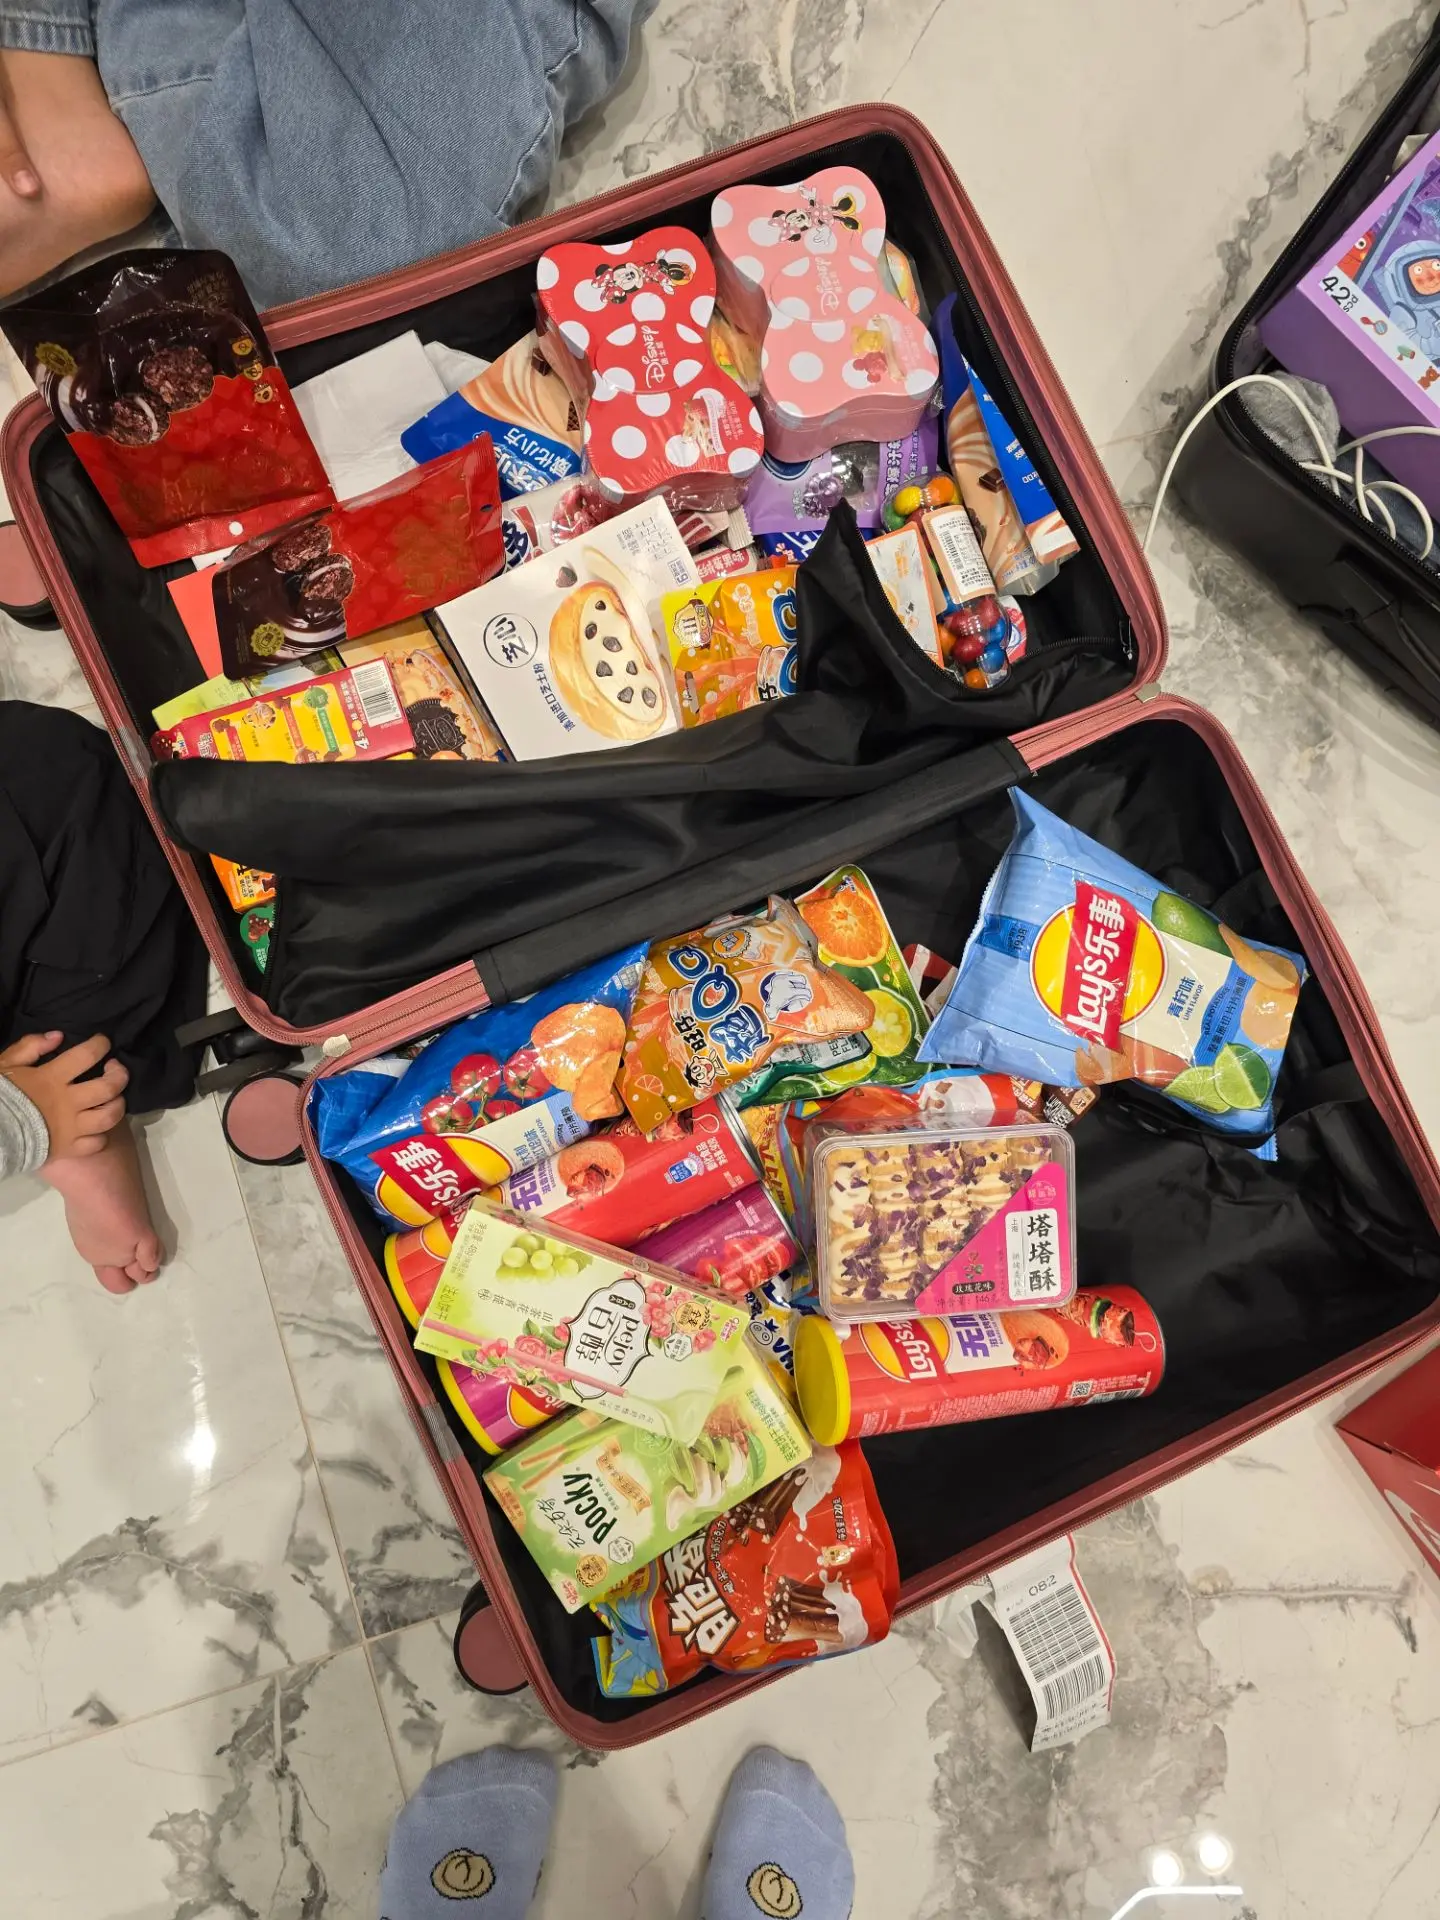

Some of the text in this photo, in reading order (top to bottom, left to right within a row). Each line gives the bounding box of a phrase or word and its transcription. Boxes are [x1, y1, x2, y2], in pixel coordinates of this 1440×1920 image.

[1322, 276, 1359, 312] 42 pcs
[503, 427, 572, 478] 威化小方
[493, 616, 529, 663] 芝心
[533, 663, 576, 732] 添加进口芝士粉
[1067, 895, 1126, 1035] Lay's 乐事
[1166, 976, 1196, 1018] 青柠味
[1183, 984, 1205, 1021] LIME FLAVOR
[675, 1014, 708, 1053] 旺仔
[390, 1140, 459, 1193] 乐事
[1027, 1213, 1057, 1293] 塔塔酥
[609, 1295, 636, 1309] GABA
[954, 1282, 994, 1295] 玫瑰花味
[576, 1306, 612, 1364] 百醇
[608, 1313, 641, 1374] pejoy
[895, 1320, 938, 1380] Lay's
[979, 1314, 1000, 1347] 滋香烤肉
[662, 1531, 741, 1655] 脆香
[1028, 1574, 1058, 1597] 082
